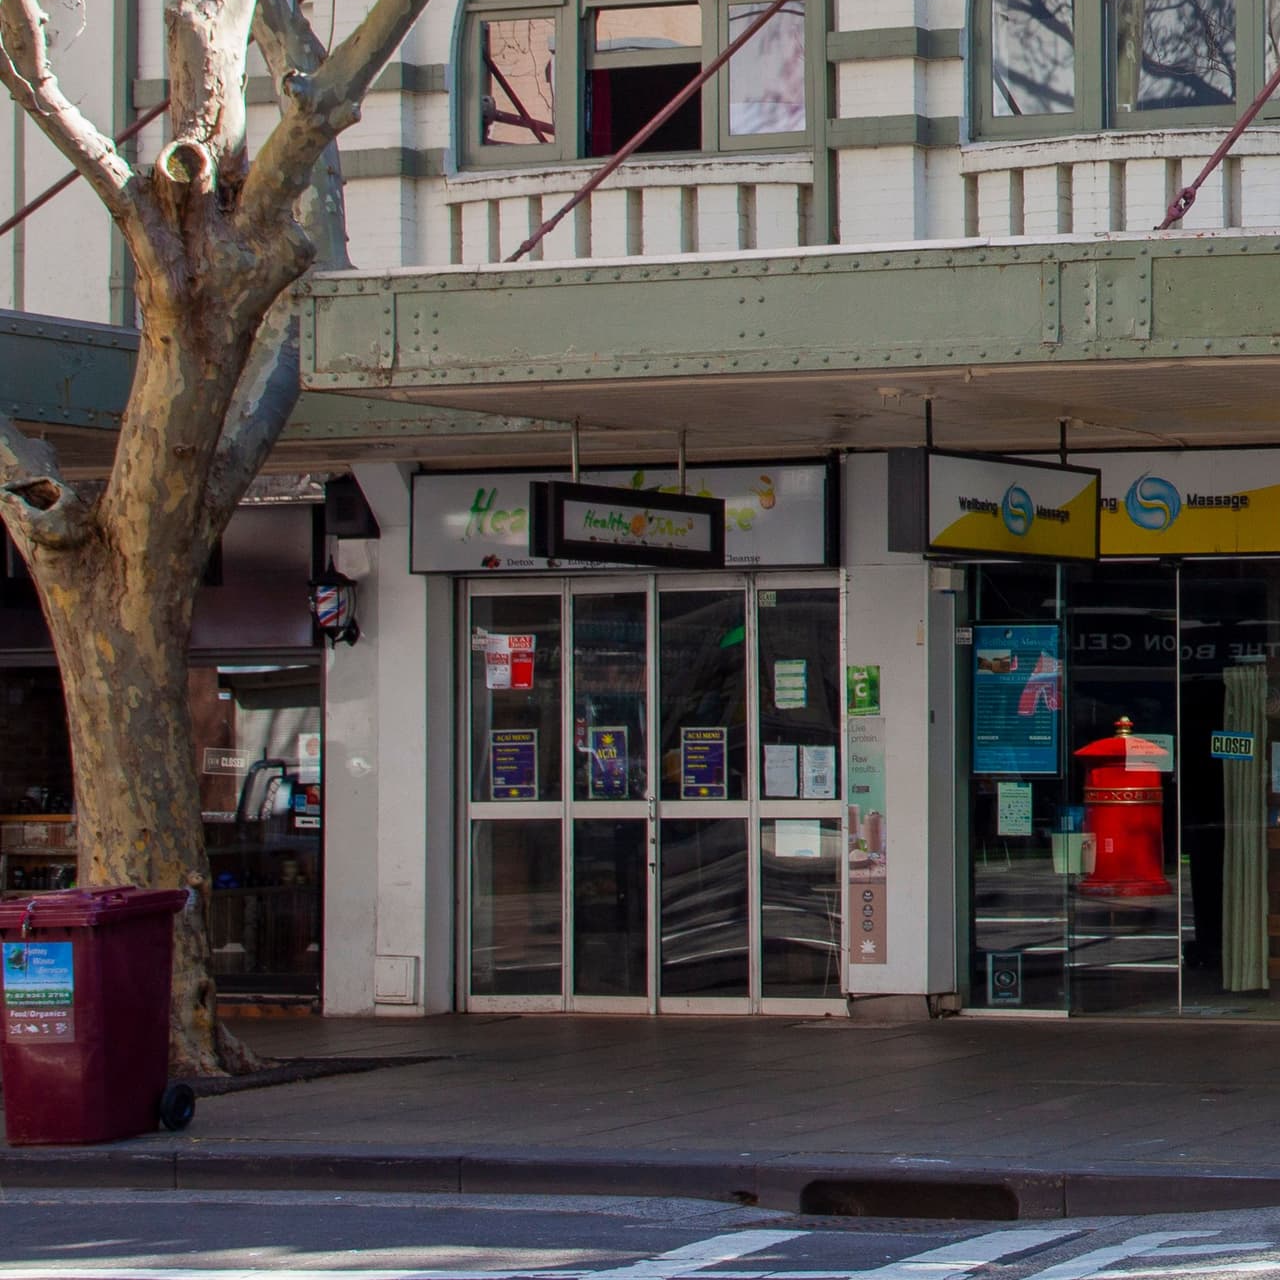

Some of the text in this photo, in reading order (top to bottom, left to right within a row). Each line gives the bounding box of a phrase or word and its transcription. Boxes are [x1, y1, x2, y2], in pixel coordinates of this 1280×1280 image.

[958, 496, 1070, 524] Wellbeing Massage
[1187, 493, 1249, 511] Massage
[583, 509, 632, 537] Healthy
[507, 558, 534, 567] Detox
[1213, 736, 1251, 754] CLOSED
[221, 757, 245, 768] CLOSED
[10, 1010, 67, 1019] Food/Organics
